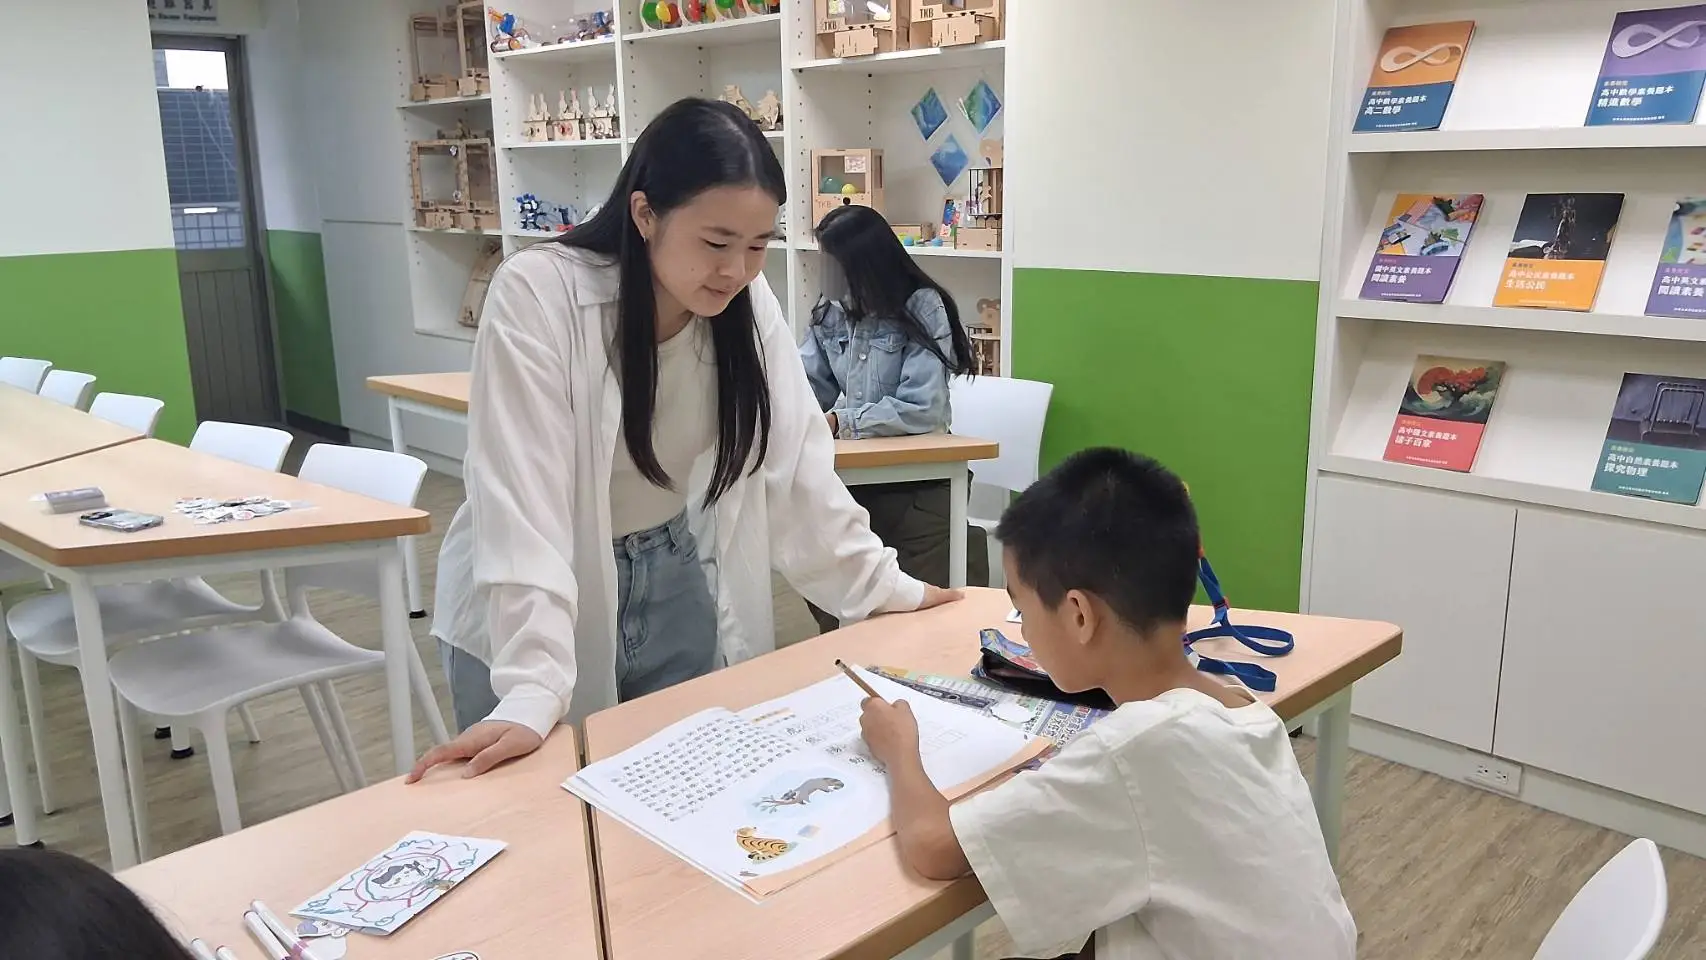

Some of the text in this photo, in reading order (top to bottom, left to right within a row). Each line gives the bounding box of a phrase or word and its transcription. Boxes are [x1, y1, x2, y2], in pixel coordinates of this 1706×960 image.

[919, 8, 934, 19] TKB
[823, 21, 837, 31] TKB
[1364, 105, 1402, 115] 高二數學
[1504, 278, 1547, 290] 生活公民
[1394, 434, 1433, 448] 諸子百家
[1603, 462, 1649, 477] 探究物理
